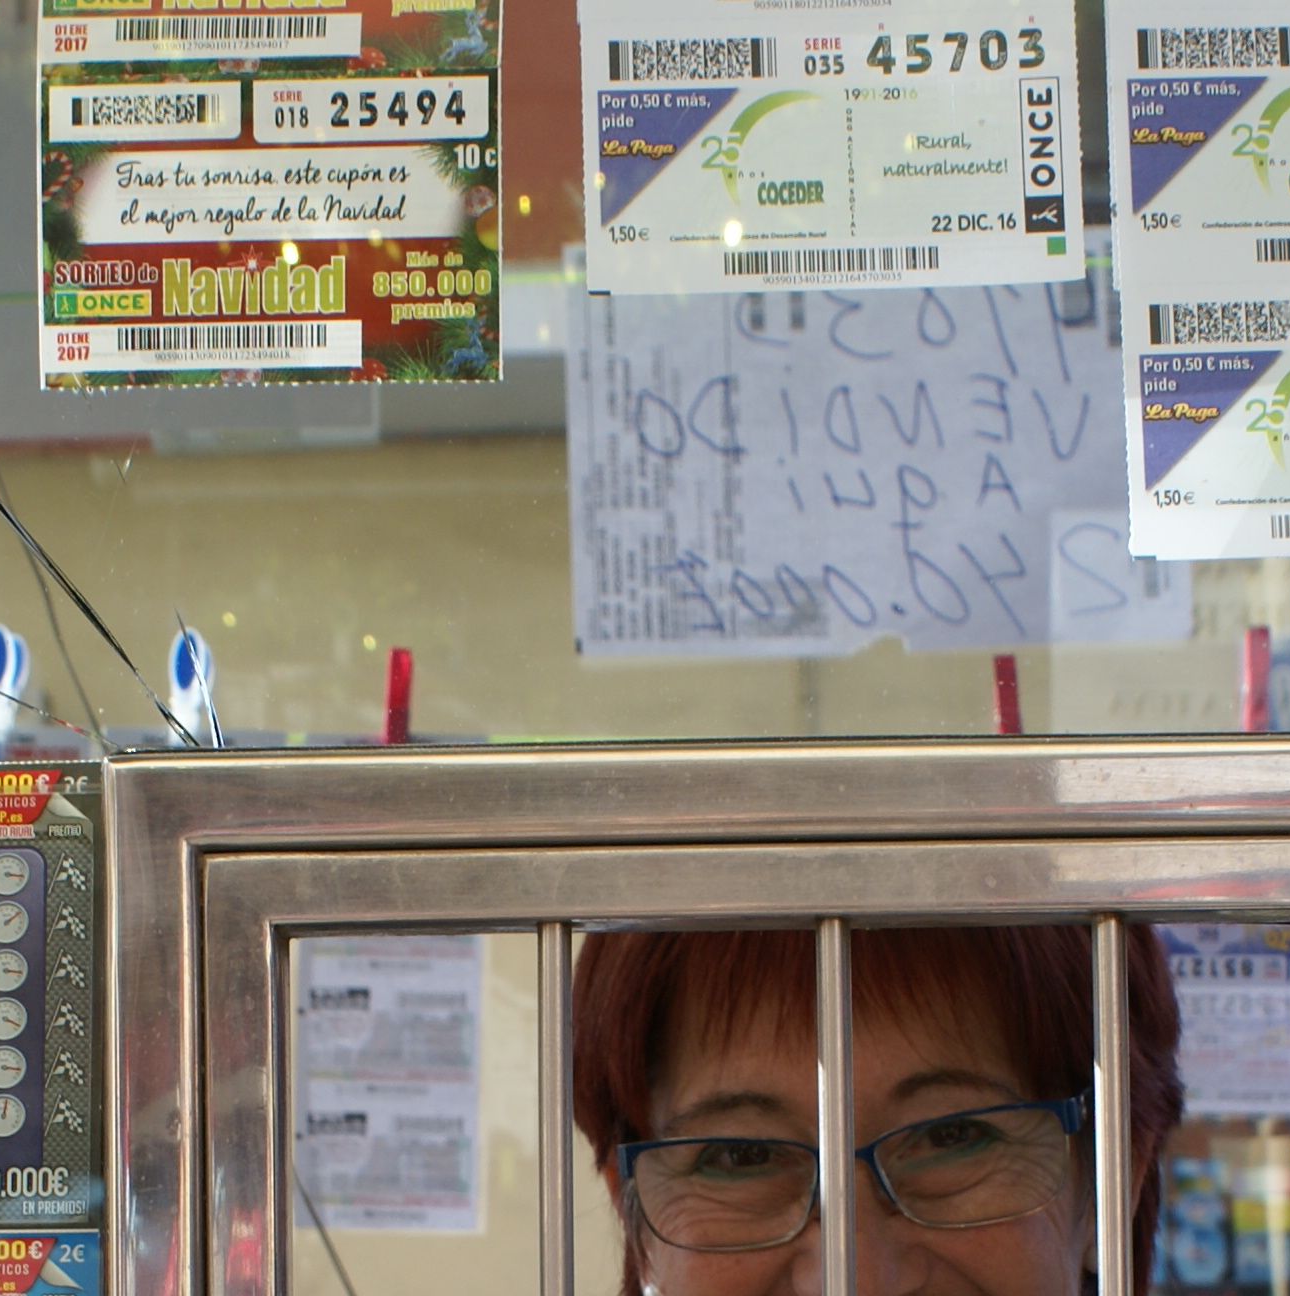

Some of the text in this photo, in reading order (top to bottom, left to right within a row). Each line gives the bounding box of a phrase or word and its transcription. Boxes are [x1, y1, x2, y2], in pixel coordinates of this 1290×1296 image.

[804, 29, 1045, 75] 035 45703
[275, 90, 466, 128] 018 25494
[1027, 87, 1057, 186] ONCE
[117, 161, 168, 189] Tras
[174, 162, 195, 186] tu
[284, 160, 322, 185] este
[327, 163, 385, 190] cupón
[389, 164, 410, 184] es
[883, 158, 1008, 178] naturalmente!
[757, 181, 824, 206] COCEDER
[120, 194, 407, 235] el mejor regalo de la Navidad
[55, 256, 346, 315] SORTEO de Navidad
[373, 270, 491, 297] 850.000
[83, 294, 144, 311] ONCE
[392, 300, 475, 323] premios
[59, 1245, 84, 1262] 2€
